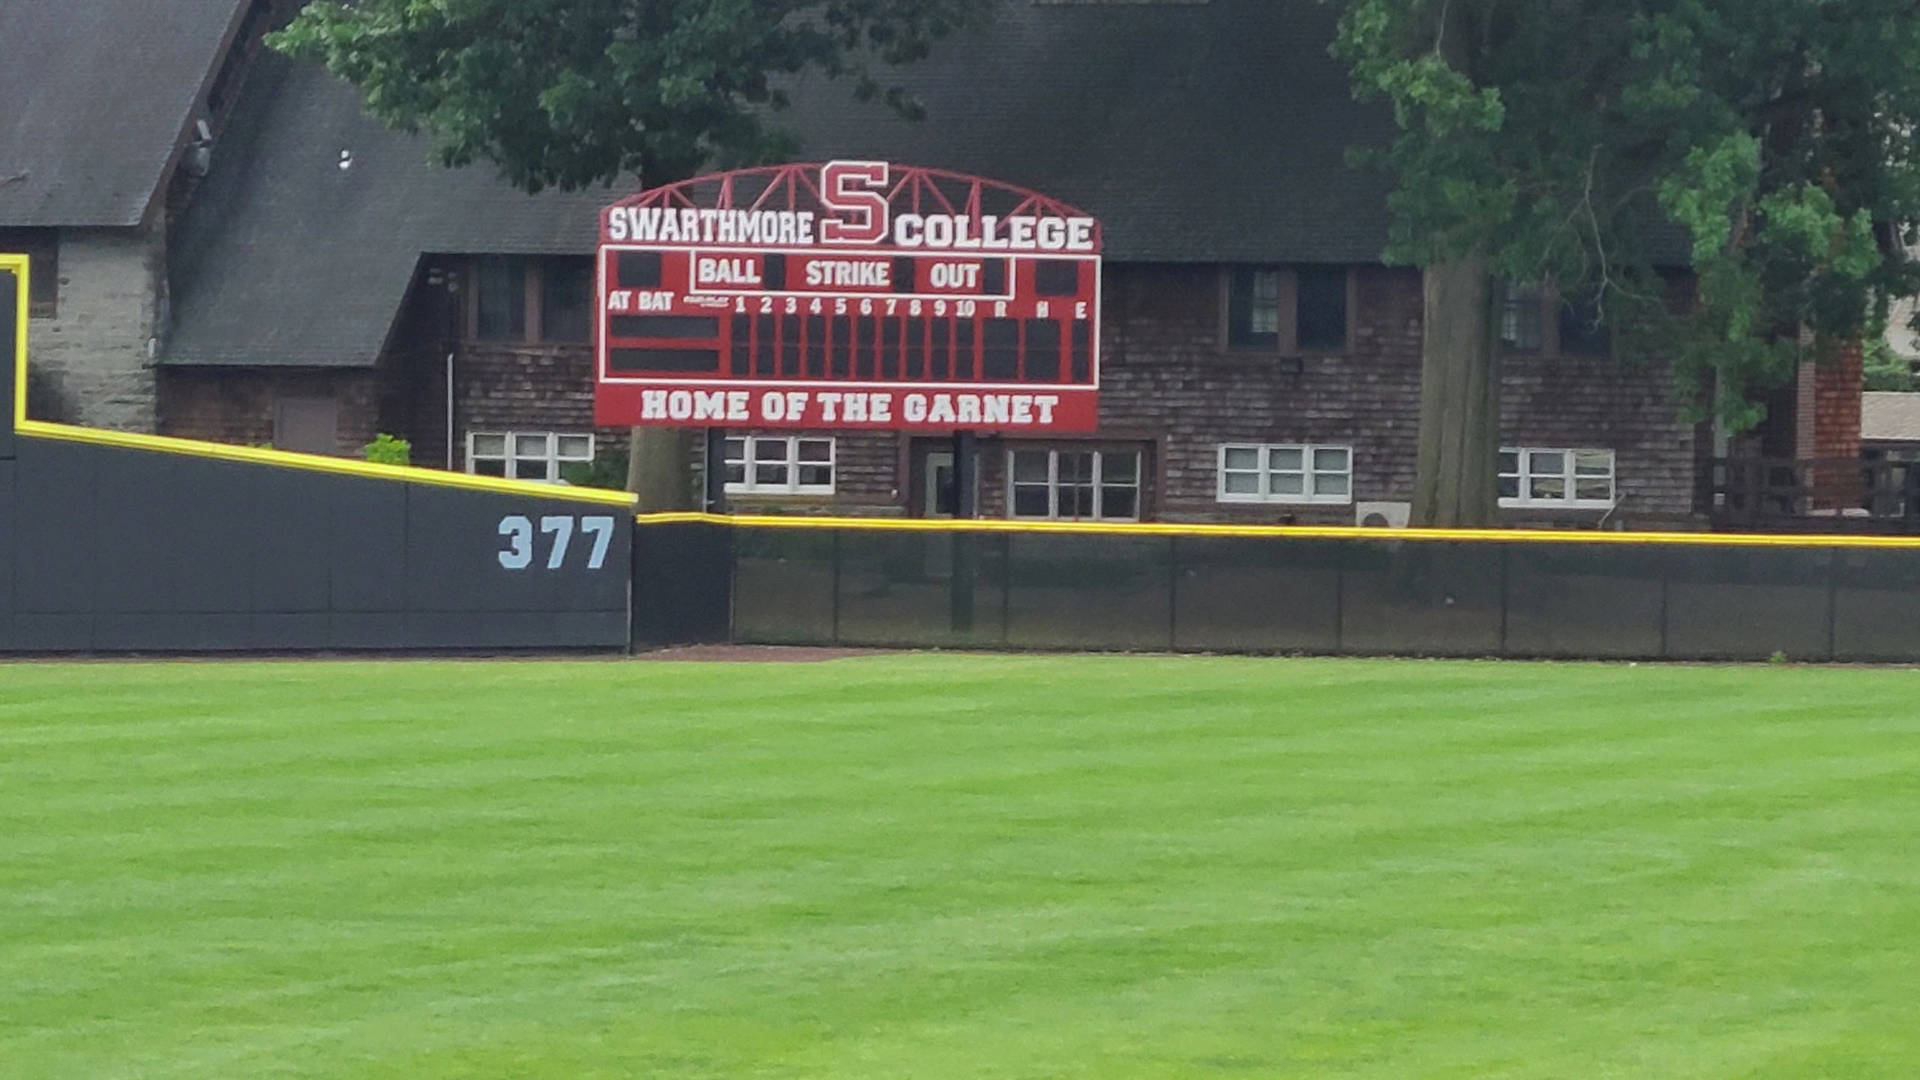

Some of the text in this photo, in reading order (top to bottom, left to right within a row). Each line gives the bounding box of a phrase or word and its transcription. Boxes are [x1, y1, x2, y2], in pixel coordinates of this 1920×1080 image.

[820, 160, 889, 245] S
[608, 206, 815, 244] SWARTHMORE
[894, 213, 1094, 250] COLLEGE
[698, 258, 761, 283] BALL
[806, 260, 890, 286] STRIKE
[930, 263, 980, 288] OUT
[607, 291, 632, 310] AT
[638, 291, 675, 311] BAT
[735, 297, 745, 313] 1
[760, 297, 773, 314] 2
[785, 298, 797, 314] 3
[809, 298, 822, 315] 4
[834, 299, 847, 315] 5
[859, 299, 872, 315] 6
[885, 300, 896, 316] 7
[909, 300, 922, 316] 8
[933, 300, 946, 317] 9
[955, 300, 975, 317] 10
[994, 301, 1007, 318] R
[1075, 302, 1087, 320] E
[641, 390, 1059, 424] HOME OF THE GARNET
[498, 515, 614, 570] 377
